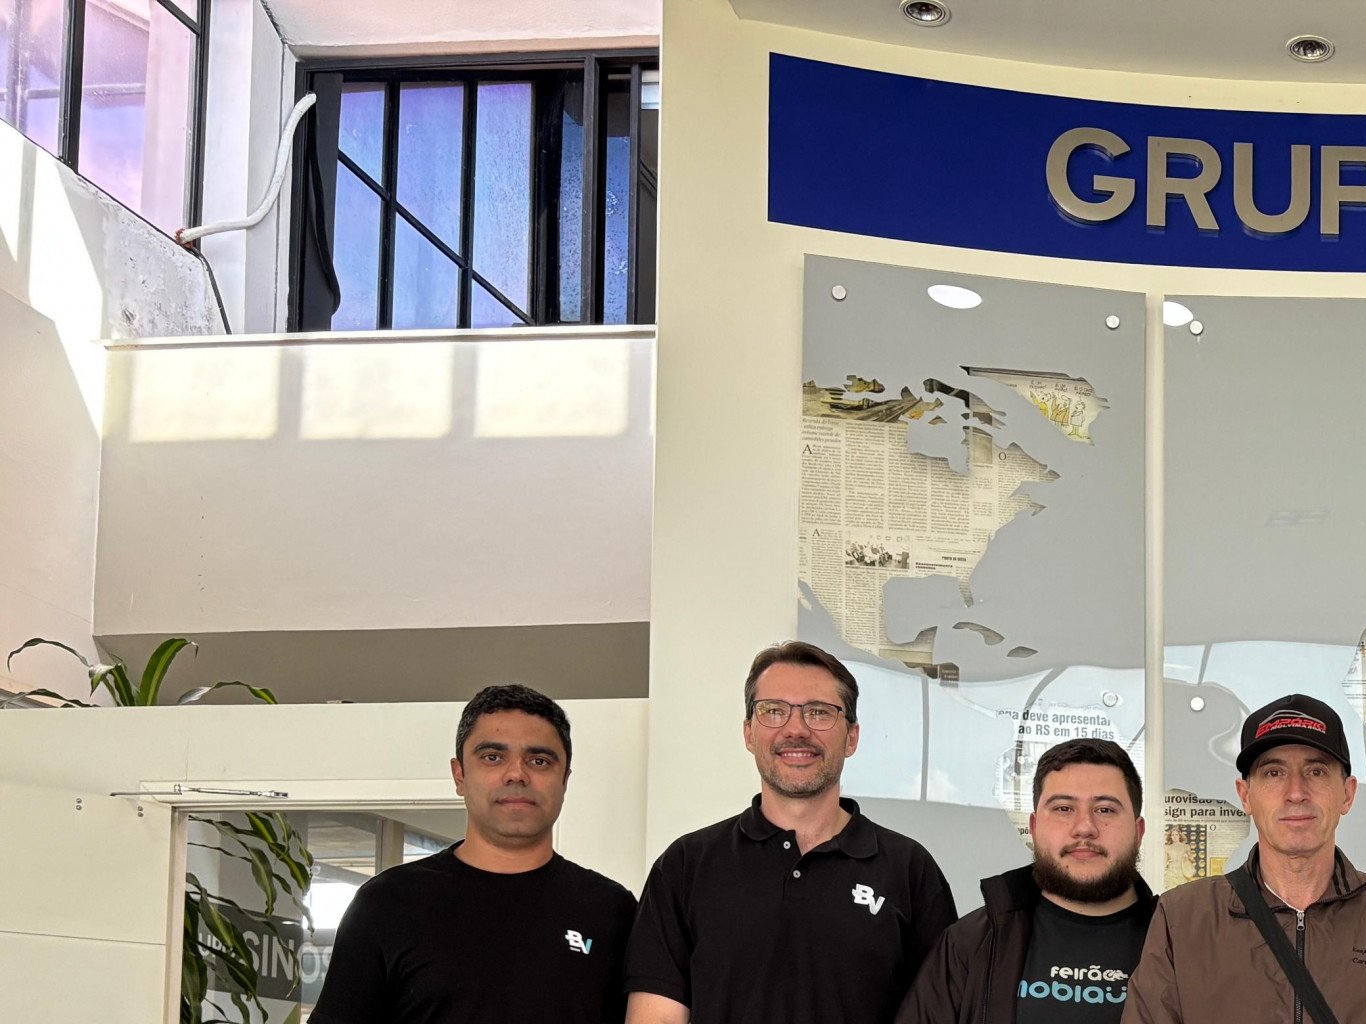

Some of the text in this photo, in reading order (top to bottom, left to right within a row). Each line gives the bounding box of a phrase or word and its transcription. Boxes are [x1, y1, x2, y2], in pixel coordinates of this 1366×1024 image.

[1022, 709, 1049, 722] deve
[1018, 724, 1115, 740] ao RS em 15 dias
[1190, 808, 1216, 818] para
